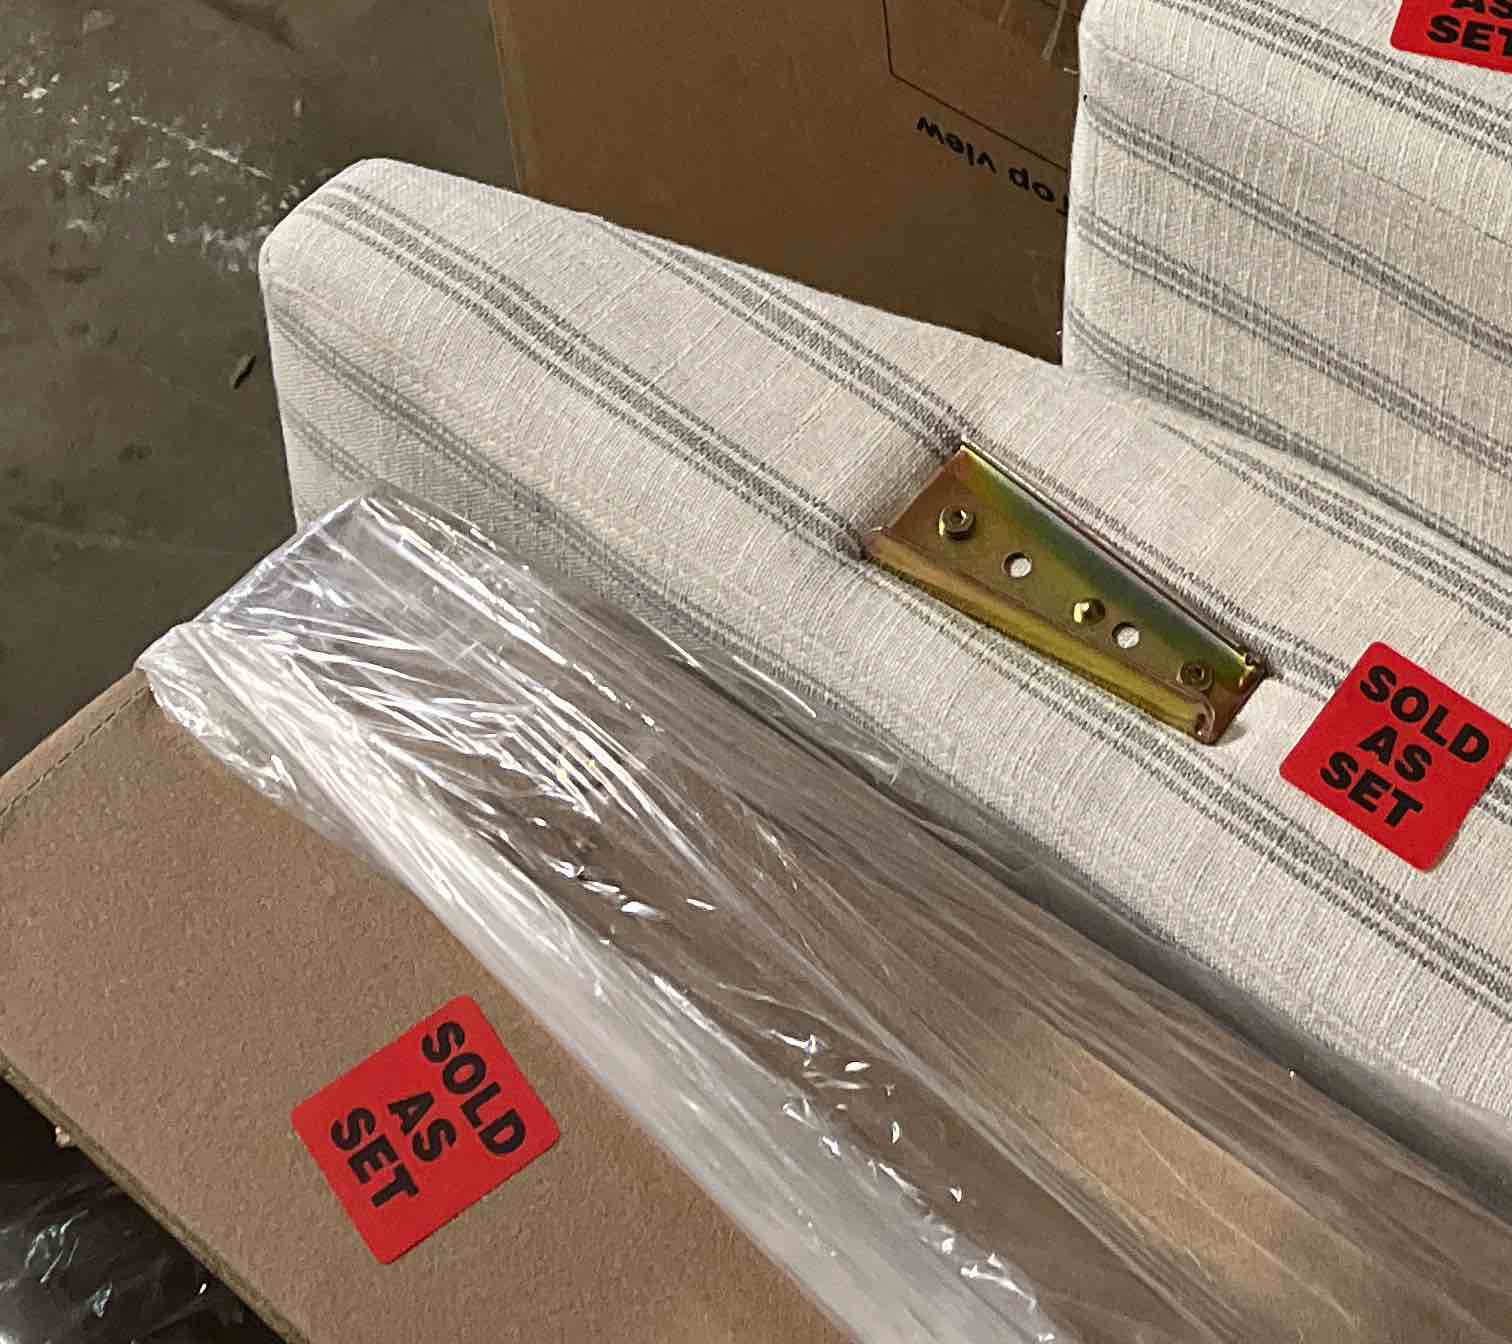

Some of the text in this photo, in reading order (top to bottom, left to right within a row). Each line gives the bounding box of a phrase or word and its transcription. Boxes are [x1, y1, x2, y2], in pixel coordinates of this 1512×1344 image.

[916, 116, 997, 173] view
[1360, 665, 1490, 763] SOLD
[1320, 751, 1424, 828] SET
[1357, 725, 1433, 782] AS
[421, 1020, 526, 1157] SOLD
[330, 1107, 419, 1208] SET
[387, 1092, 457, 1163] AS
